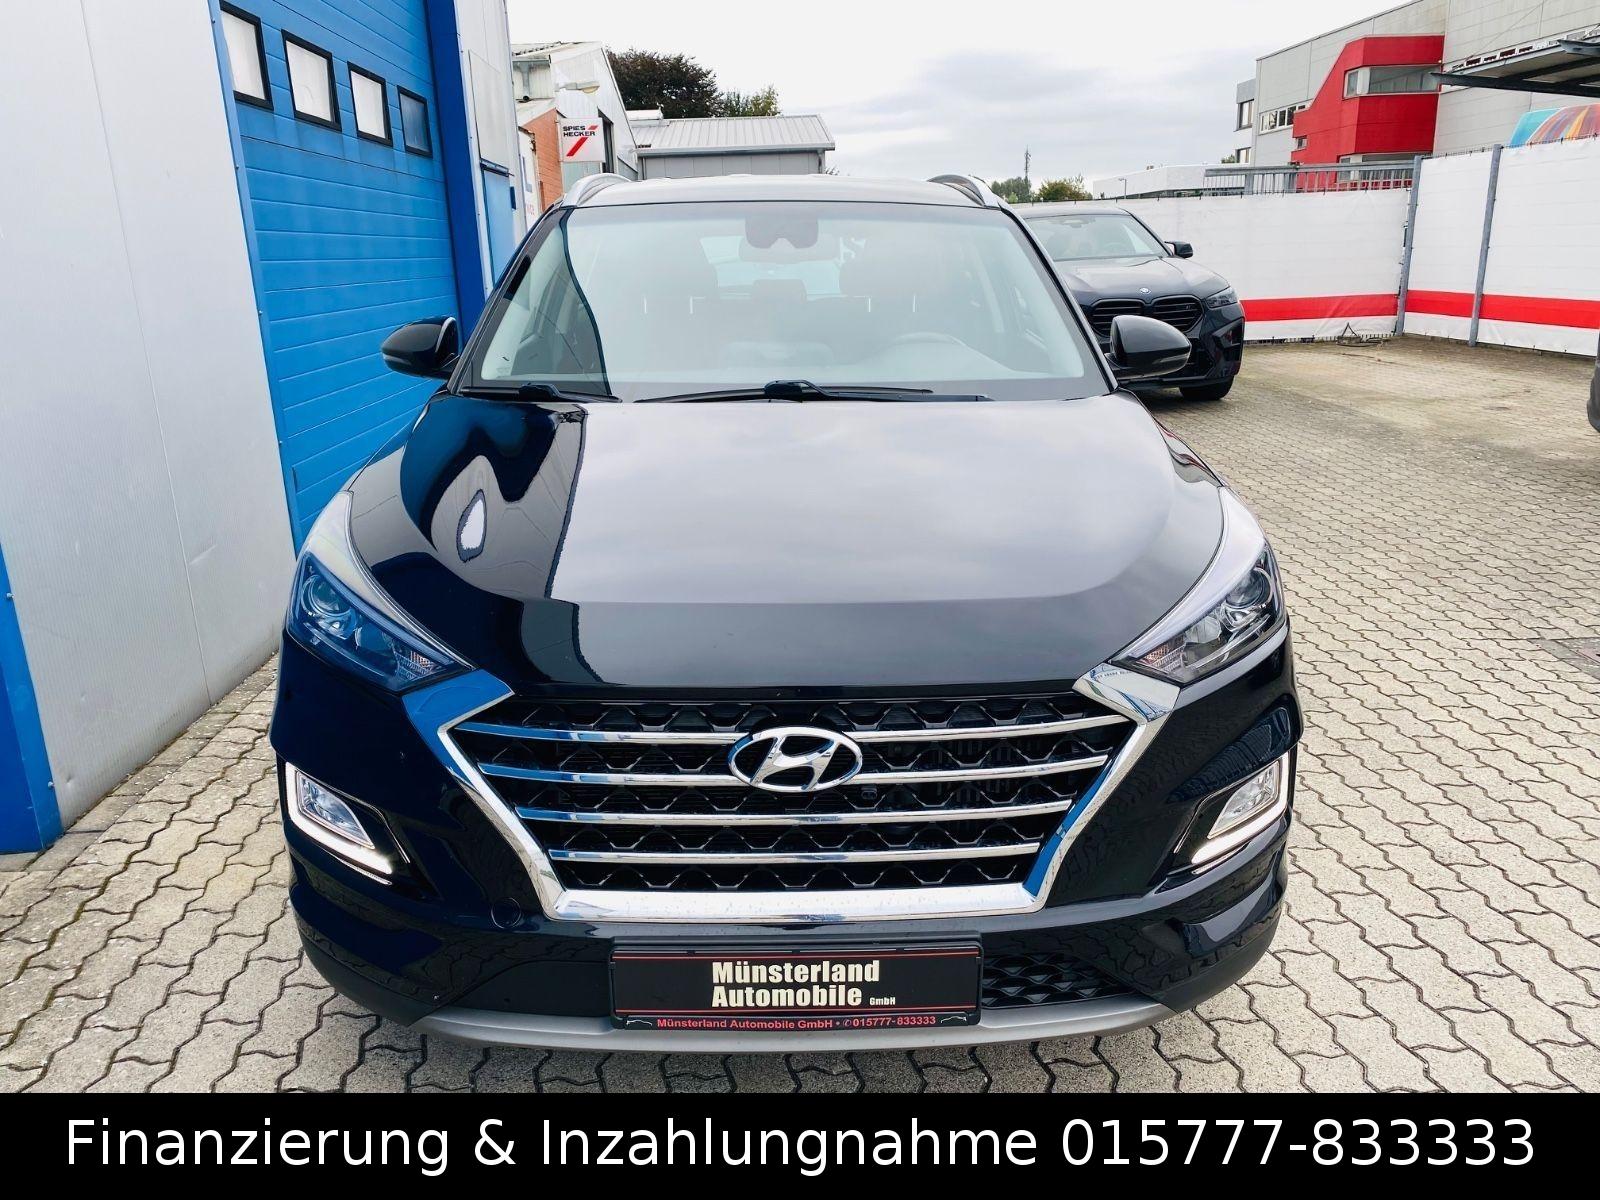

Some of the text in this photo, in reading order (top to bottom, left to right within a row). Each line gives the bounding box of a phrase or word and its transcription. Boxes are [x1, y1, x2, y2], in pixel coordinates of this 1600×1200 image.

[712, 961, 880, 983] Münsterland
[711, 985, 896, 1008] Automobile GmbH
[657, 1016, 936, 1029] Münsterland Automobile GmbH 015777-833333
